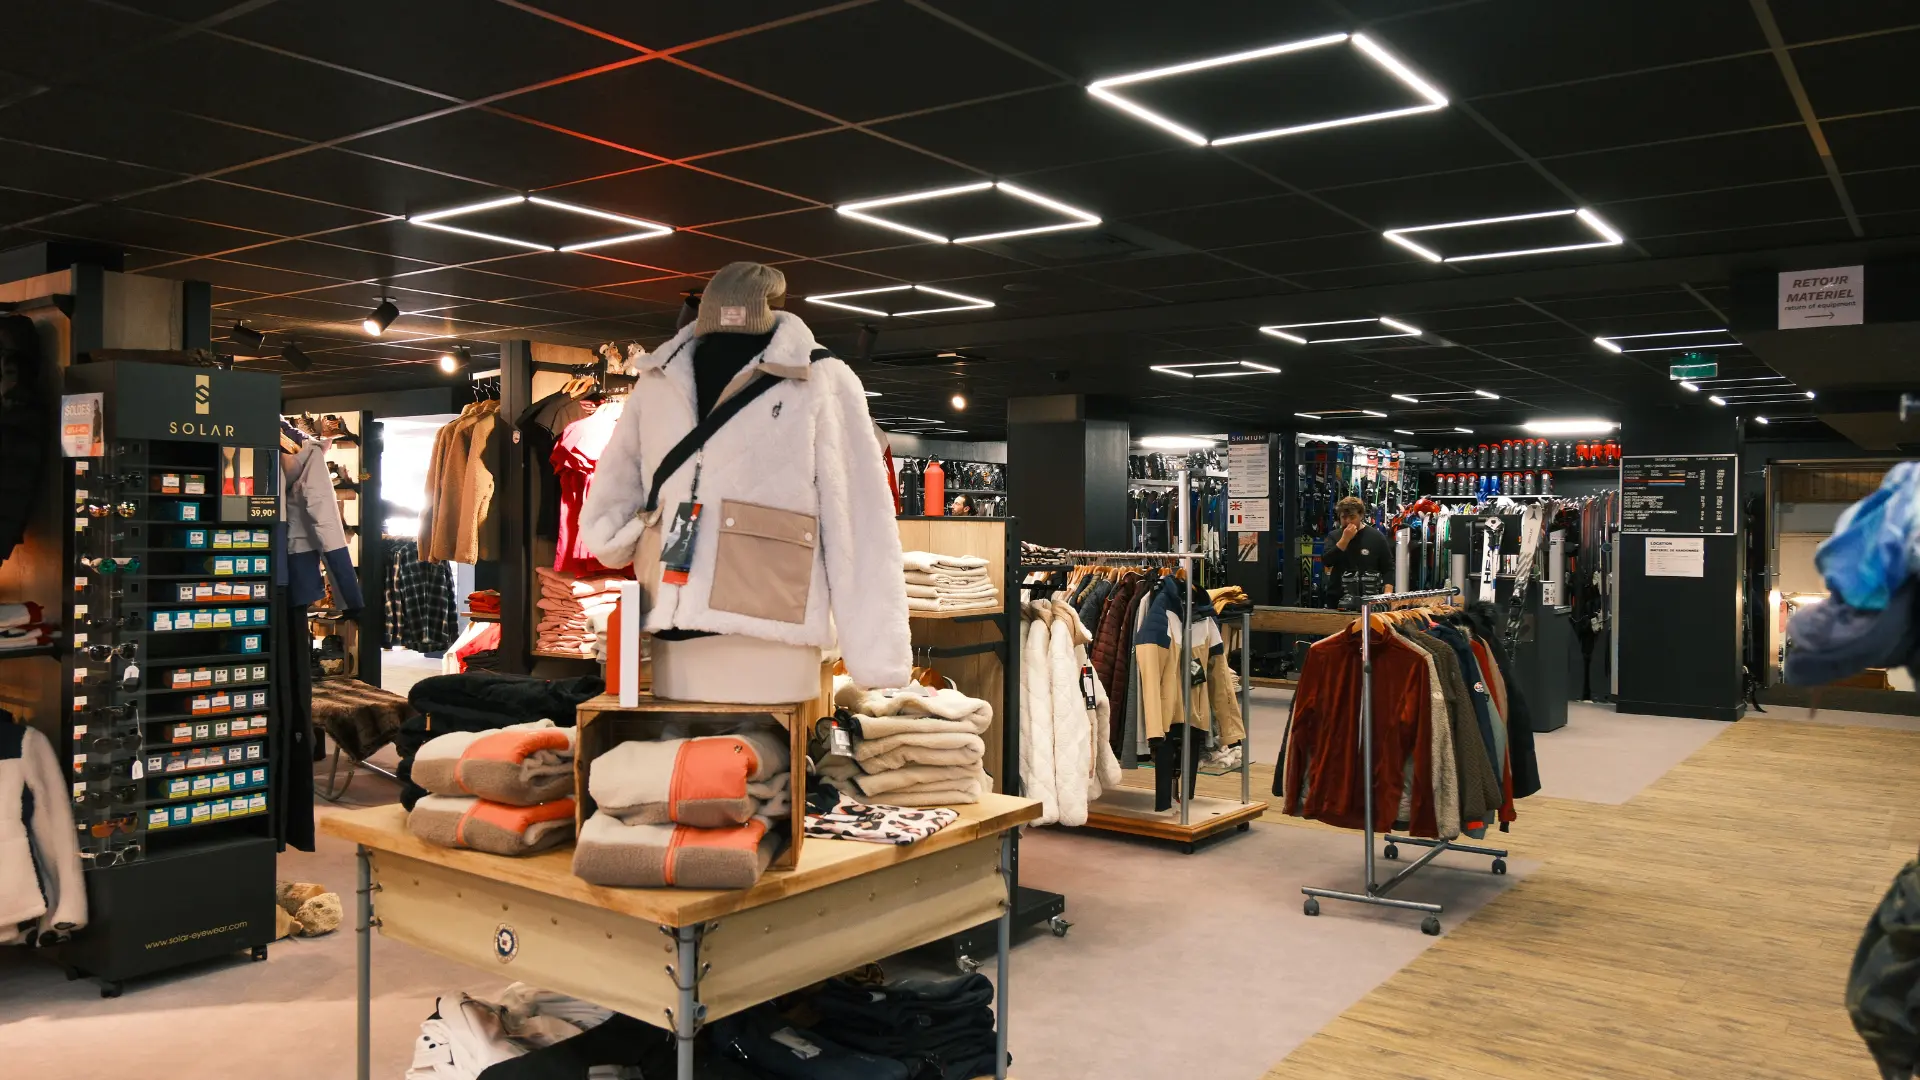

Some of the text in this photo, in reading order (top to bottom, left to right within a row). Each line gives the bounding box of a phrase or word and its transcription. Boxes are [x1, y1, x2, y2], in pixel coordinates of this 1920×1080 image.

[1792, 275, 1849, 289] RETOUR
[1786, 289, 1855, 303] MATERIEL
[169, 421, 234, 437] SOLAR
[144, 921, 248, 950] www.solar-eyewear.com
